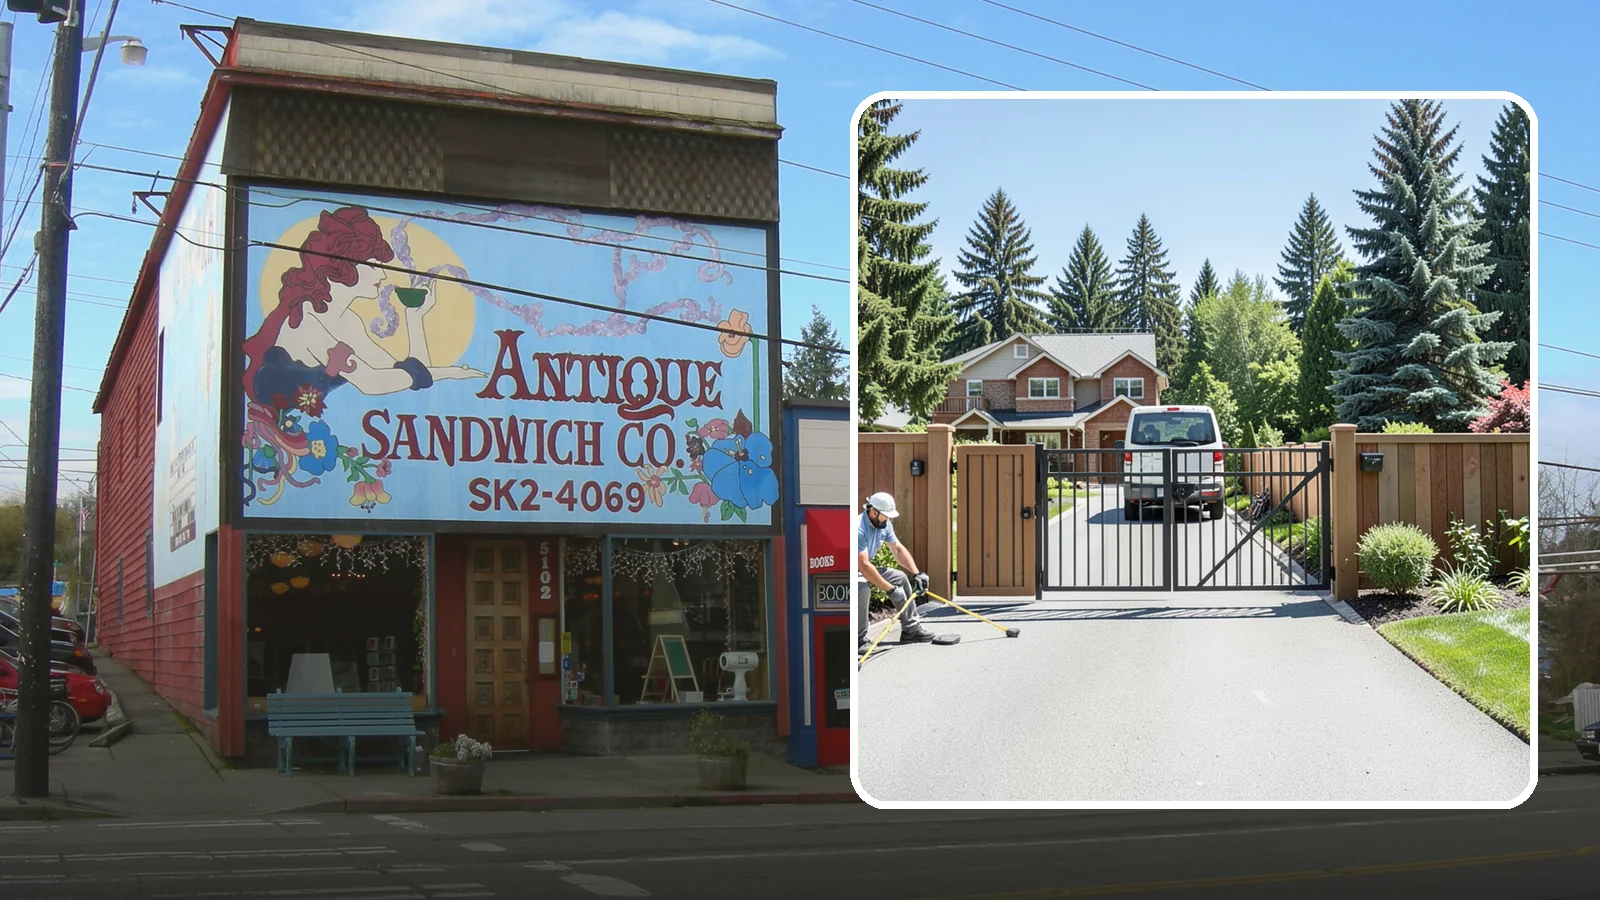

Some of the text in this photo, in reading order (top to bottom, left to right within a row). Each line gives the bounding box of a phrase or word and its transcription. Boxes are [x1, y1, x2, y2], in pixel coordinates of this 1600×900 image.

[477, 329, 723, 420] ANTIQUE
[361, 409, 685, 469] SANDWICH CO.
[468, 477, 647, 512] SK2-4069
[539, 542, 552, 600] 5102
[809, 555, 835, 569] BOOKS
